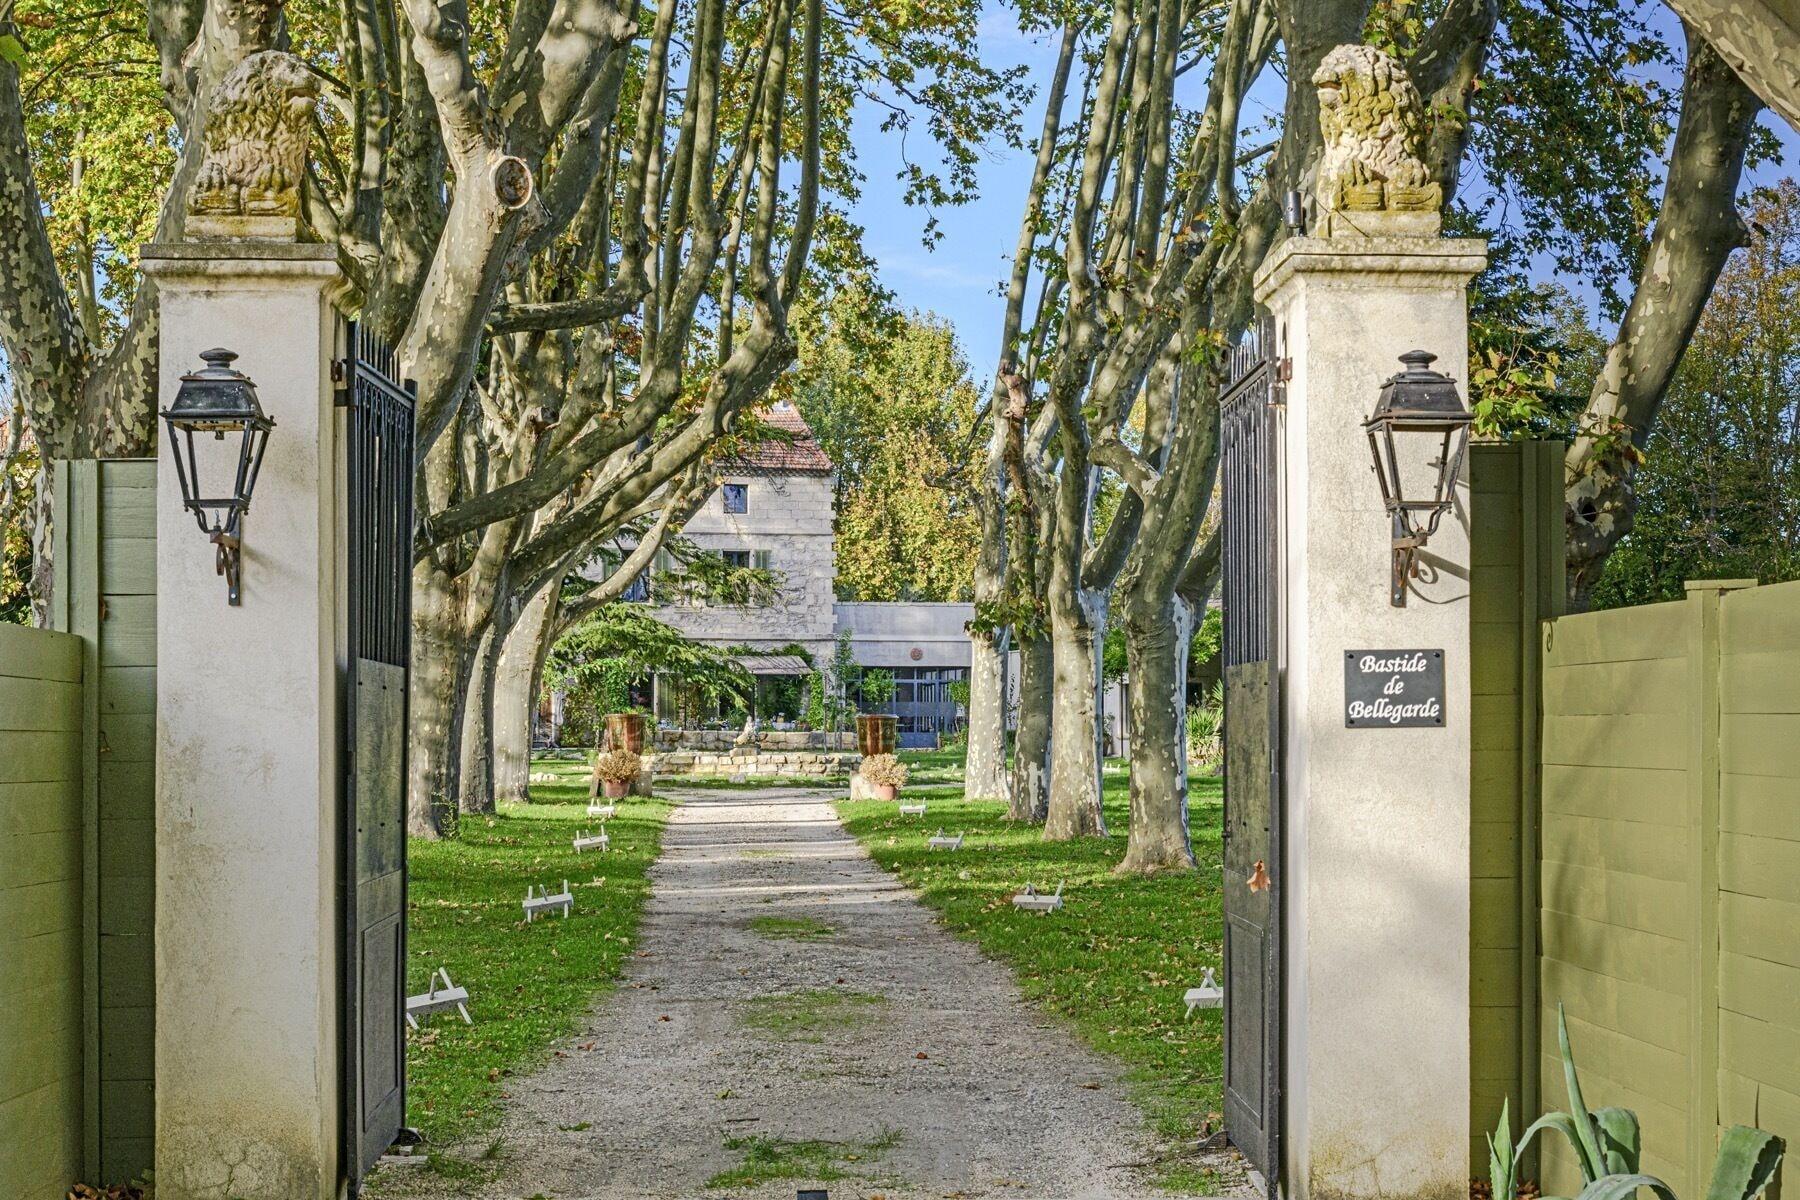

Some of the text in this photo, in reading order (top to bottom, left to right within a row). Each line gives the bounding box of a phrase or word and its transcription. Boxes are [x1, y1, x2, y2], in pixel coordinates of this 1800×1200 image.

[1360, 652, 1427, 673] Bastide
[1383, 675, 1404, 695] de
[1348, 697, 1440, 724] Bellegarde
